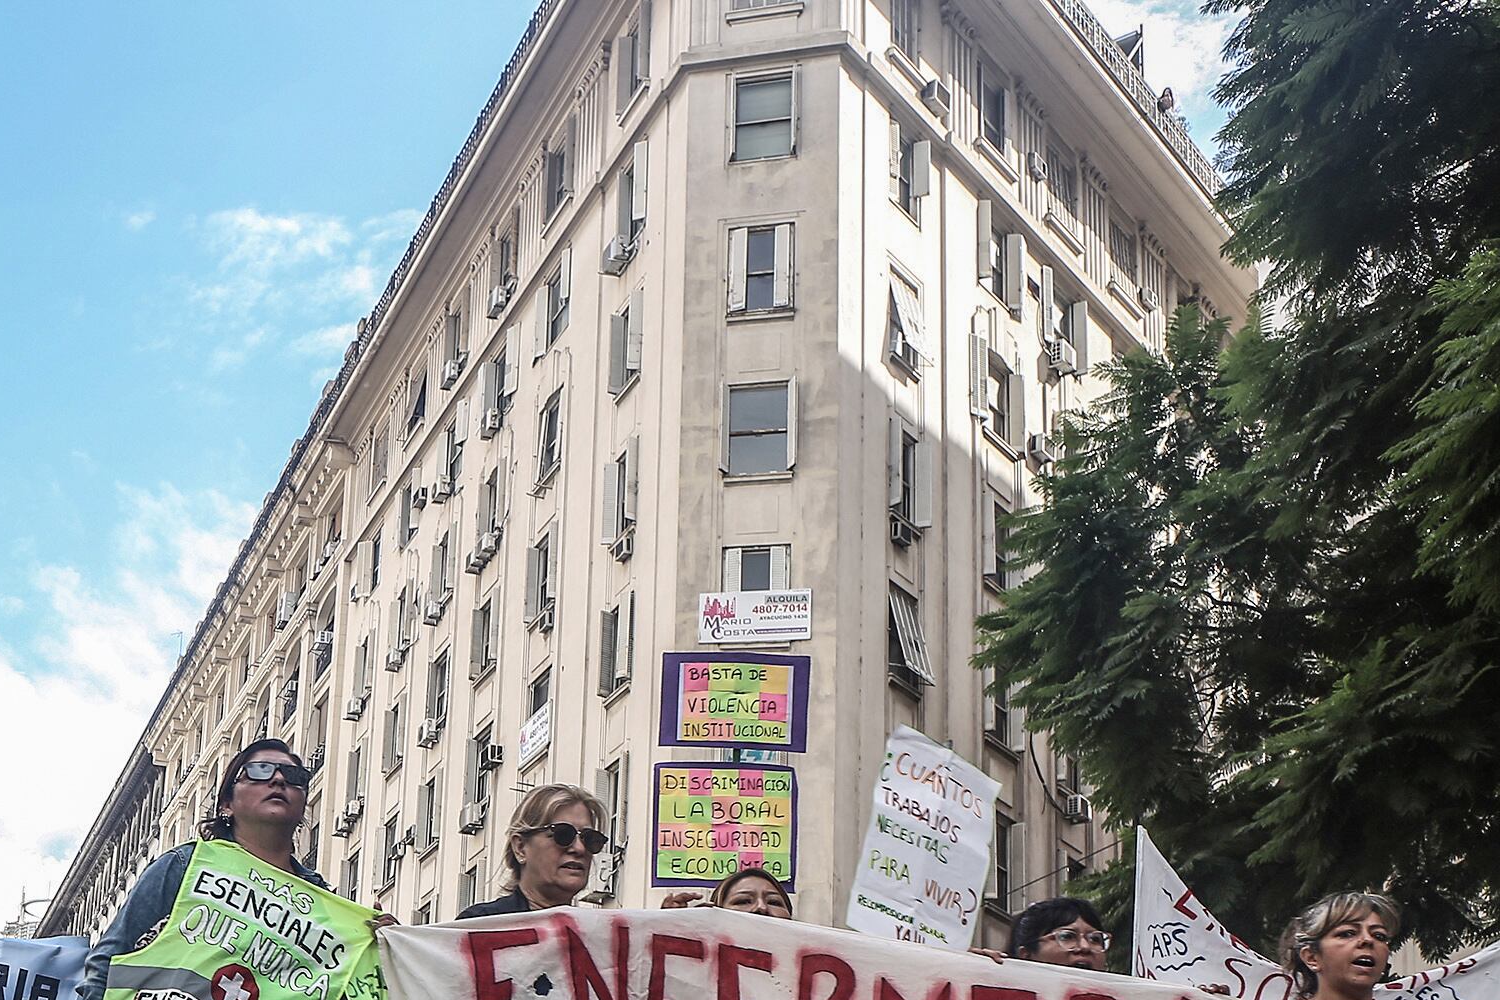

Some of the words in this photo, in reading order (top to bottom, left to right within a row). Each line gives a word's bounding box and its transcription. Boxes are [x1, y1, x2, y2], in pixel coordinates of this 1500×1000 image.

[766, 594, 808, 603] ALQUILA
[752, 603, 808, 615] 4807-7014
[704, 616, 752, 629] MARIO
[711, 626, 757, 640] COSTA
[688, 667, 743, 681] BASTA
[748, 668, 768, 681] DE
[688, 697, 777, 715] VIOLENCIA
[683, 721, 786, 740] INSTITUCIONAL
[663, 769, 791, 792] DISCRIMINACIÓN
[673, 801, 785, 819] LABORAL
[660, 829, 782, 849] INSEGURIDAD
[875, 813, 950, 865] NECESITAS
[869, 849, 911, 884] PARA
[179, 903, 248, 956] QUE
[193, 870, 347, 971] ESENCIALES
